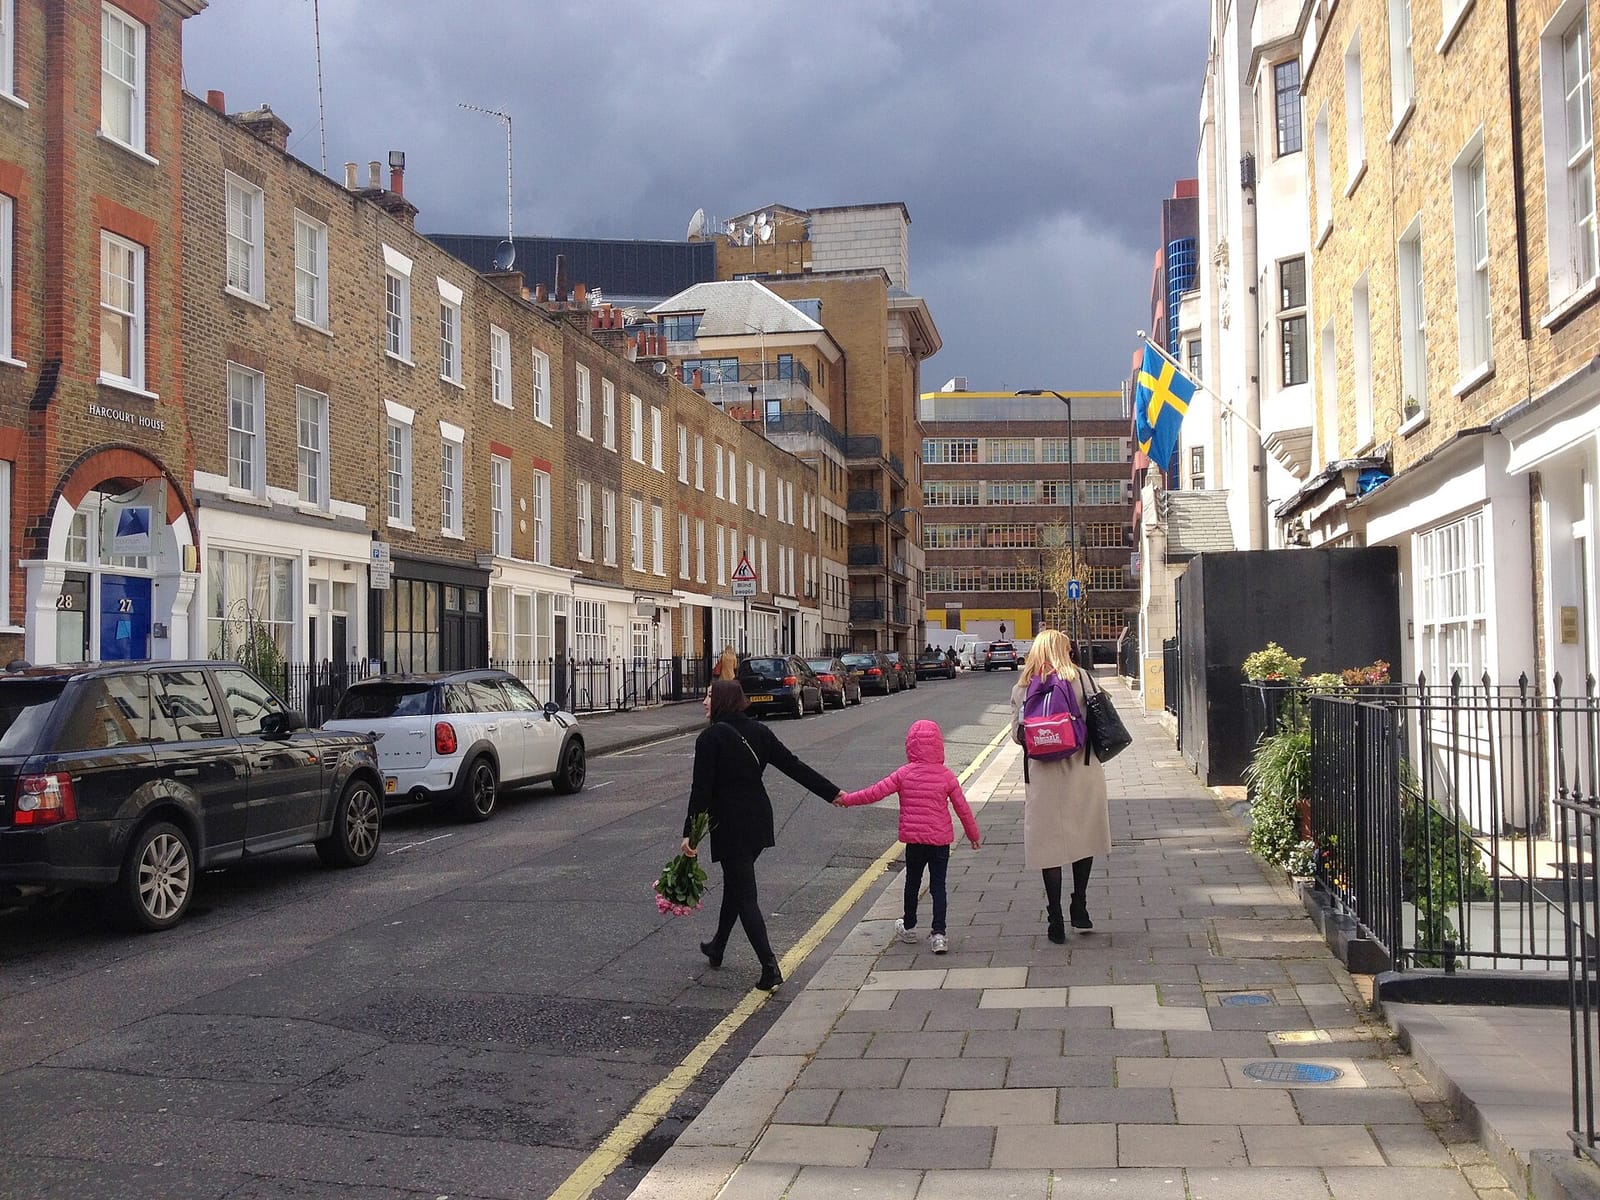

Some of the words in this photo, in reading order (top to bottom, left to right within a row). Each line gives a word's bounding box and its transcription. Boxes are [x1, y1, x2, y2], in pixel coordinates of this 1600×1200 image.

[89, 404, 135, 424] HARCOURT
[139, 415, 165, 431] HOUSE
[57, 594, 73, 609] 28
[119, 599, 132, 612] 27
